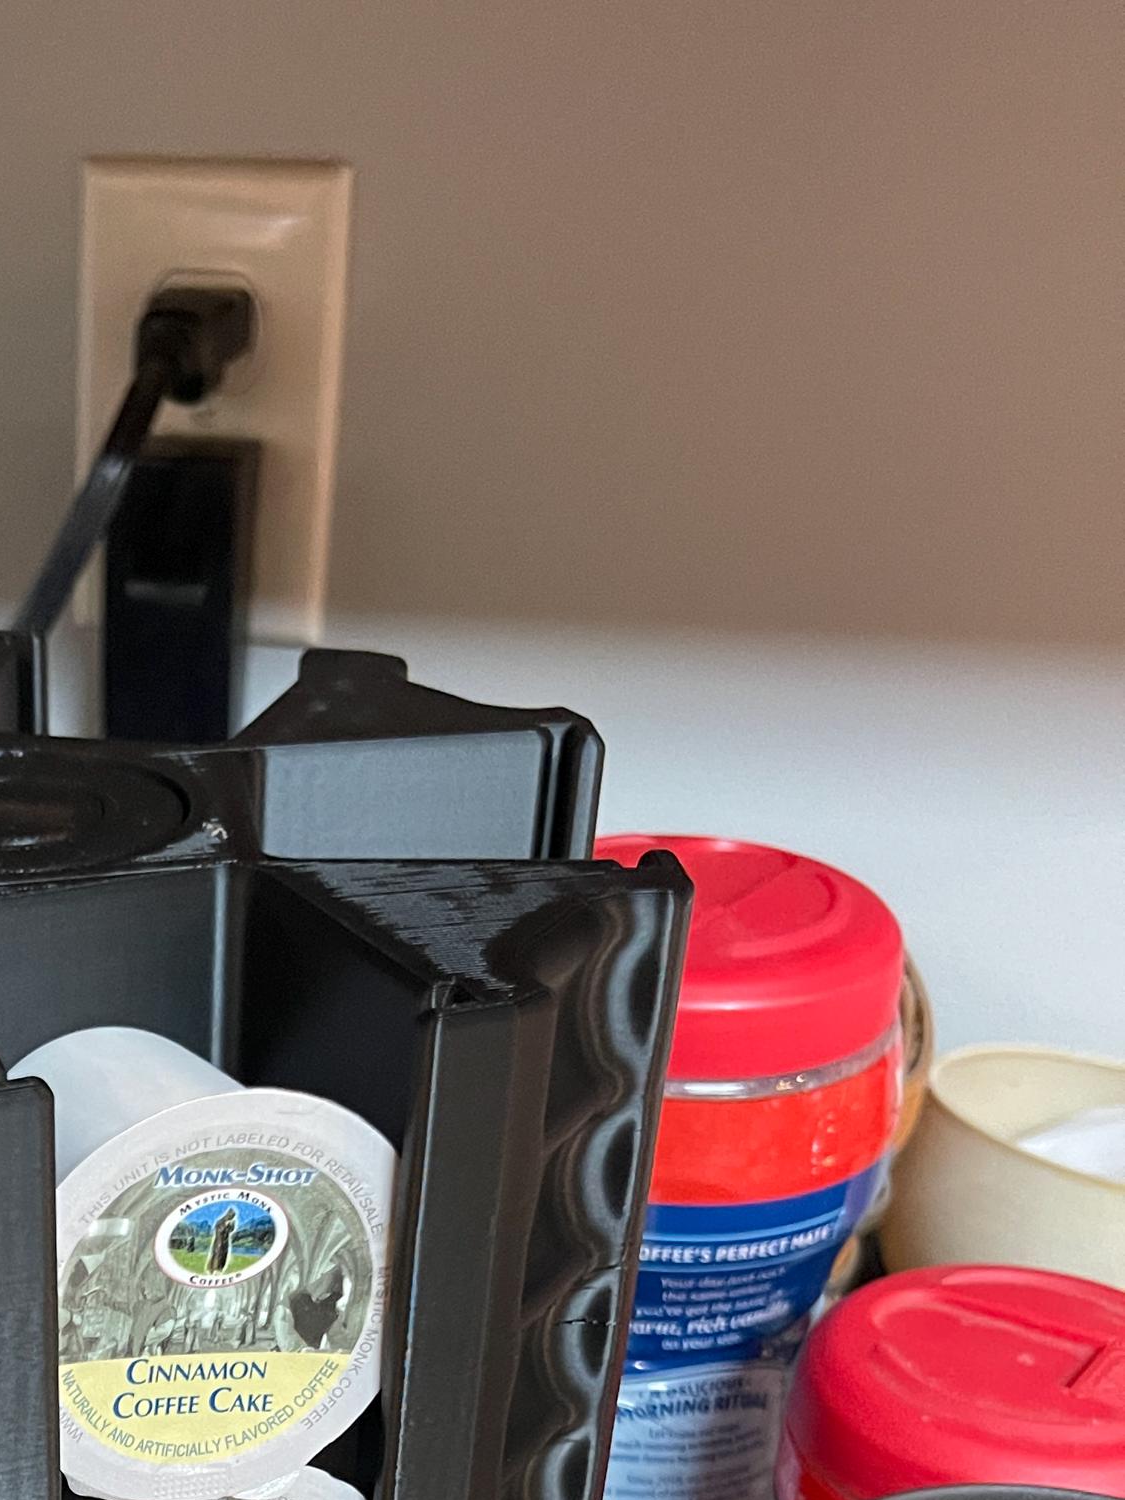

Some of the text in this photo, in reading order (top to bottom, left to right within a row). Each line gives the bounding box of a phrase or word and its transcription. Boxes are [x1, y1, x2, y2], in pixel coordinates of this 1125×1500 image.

[80, 1191, 111, 1224] THIS
[115, 1163, 151, 1191] UNIT
[154, 1153, 170, 1165] IS
[175, 1138, 213, 1156] NOT
[216, 1133, 290, 1148] LABELED
[292, 1142, 324, 1163] FOR
[155, 1162, 317, 1187] MONK-SHOT
[180, 1191, 273, 1215] MYSTIC MONK
[639, 1245, 712, 1263] OFFEE'S
[715, 1237, 791, 1262] PERFECT
[350, 1328, 380, 1375] MONK
[126, 1358, 268, 1385] CINNAMON
[61, 1359, 339, 1457] NATURALLY AND ARTIFICIALLY FLAVORED COFFEE
[113, 1387, 274, 1419] COFFEE CAKE
[302, 1378, 351, 1430] COFFEE
